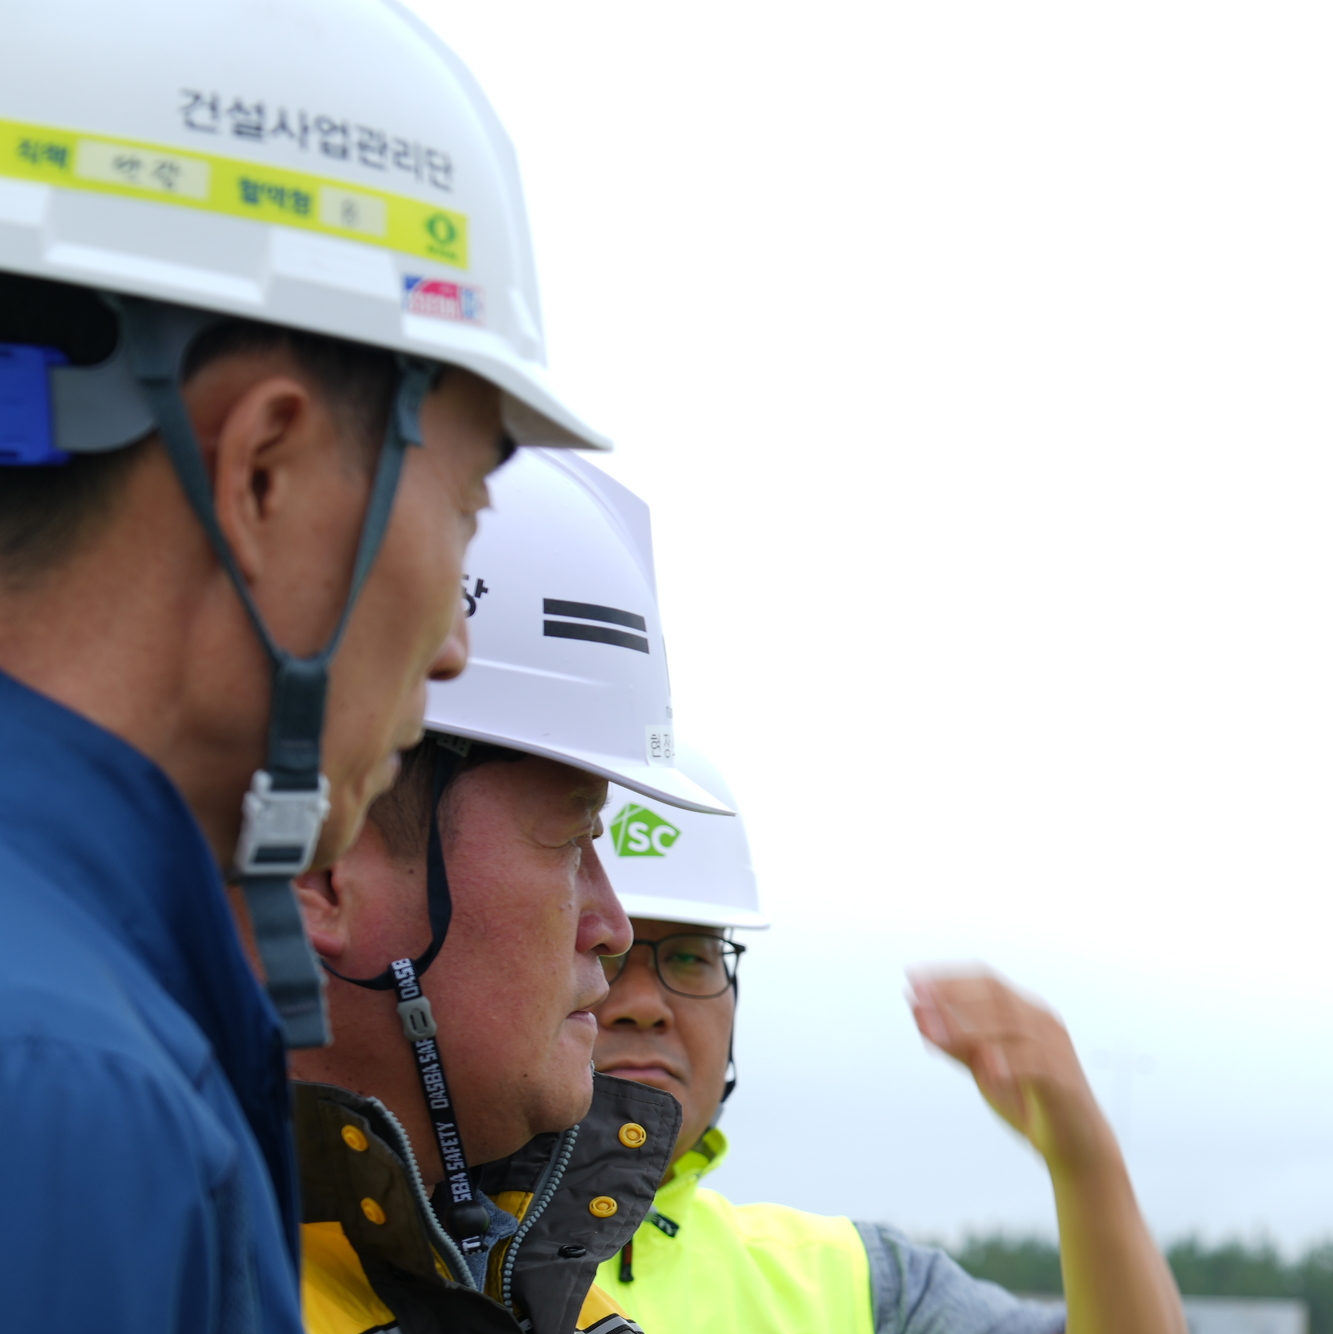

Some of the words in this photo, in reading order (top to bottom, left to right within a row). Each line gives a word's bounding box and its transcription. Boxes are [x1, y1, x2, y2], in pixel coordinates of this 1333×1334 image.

[180, 87, 454, 193] 건설사업관리단
[627, 821, 678, 856] SC
[421, 1063, 449, 1109] DASBA
[436, 1122, 466, 1170] SAFETY
